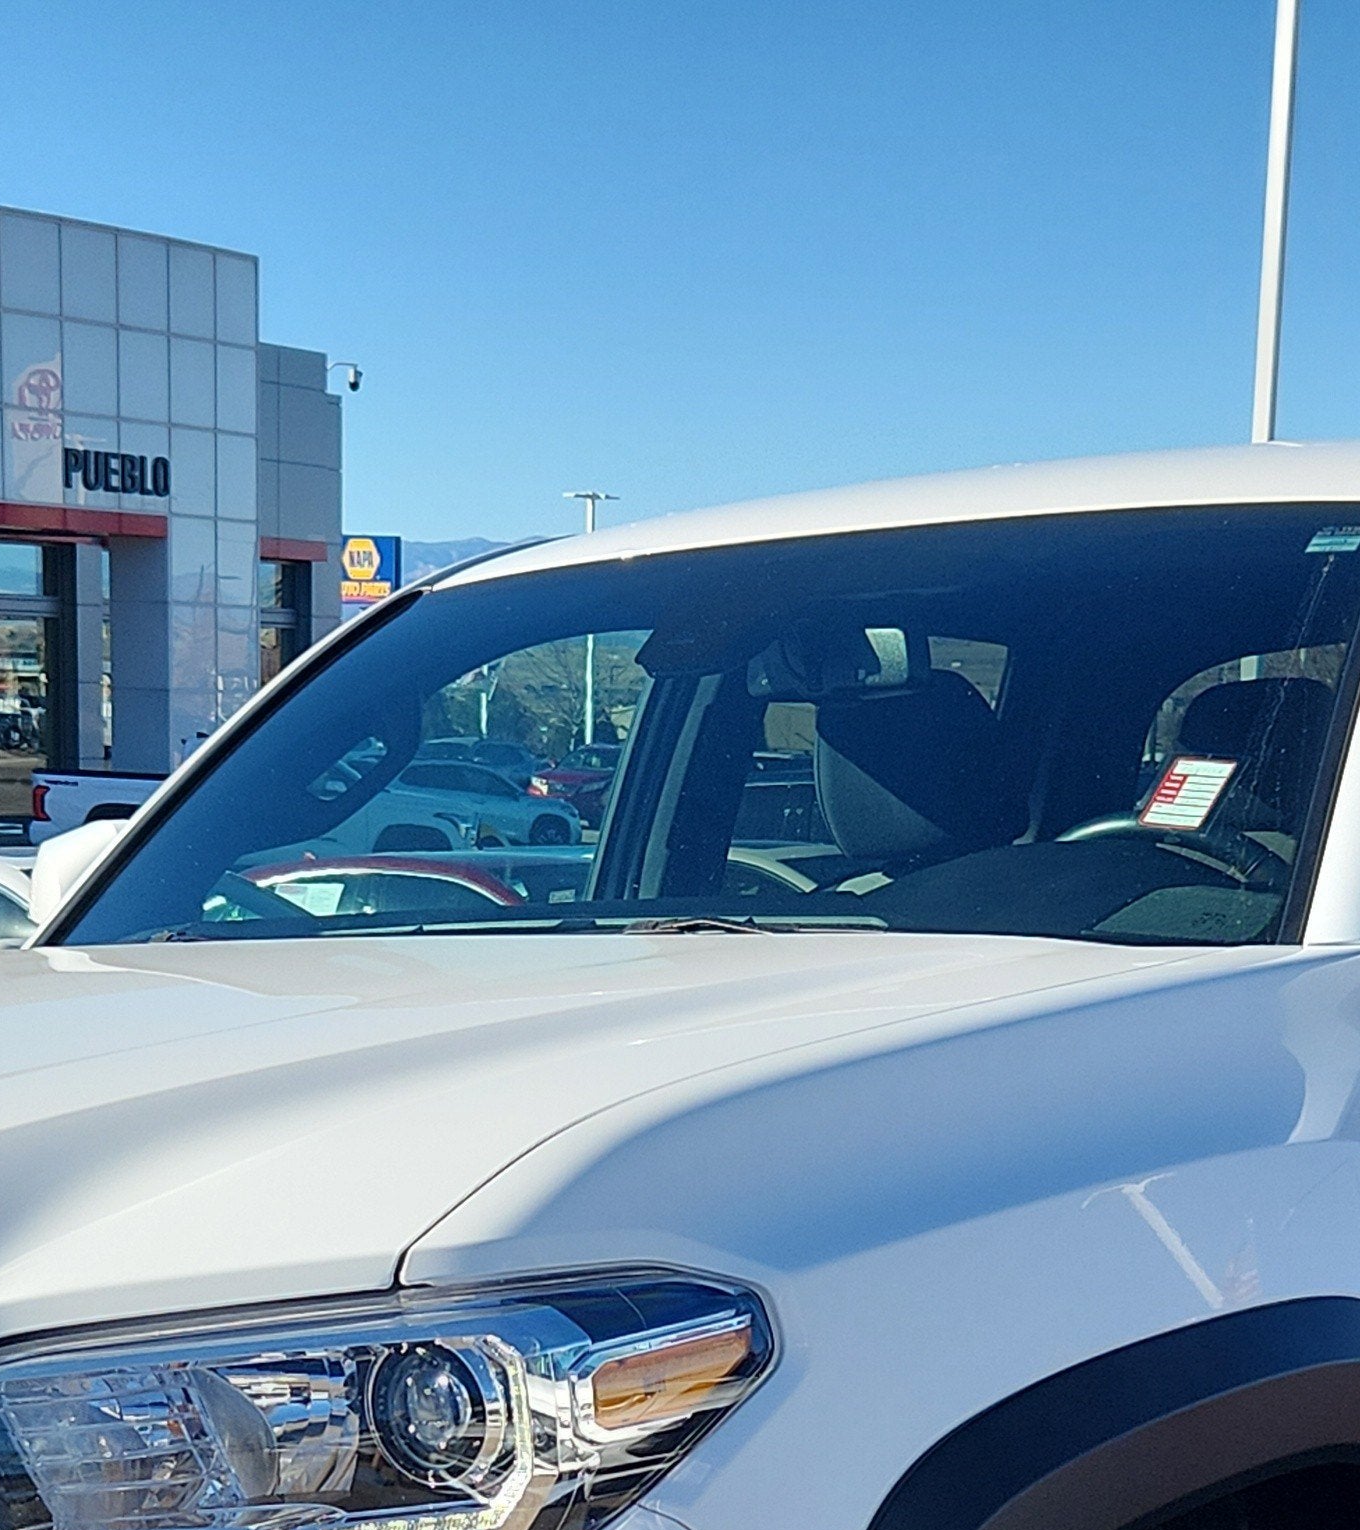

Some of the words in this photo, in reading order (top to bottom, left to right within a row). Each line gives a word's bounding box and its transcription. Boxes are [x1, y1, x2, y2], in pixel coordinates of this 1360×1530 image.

[62, 447, 171, 497] PUEBLO
[349, 550, 374, 568] NAPA
[341, 581, 359, 597] UTO
[361, 581, 391, 598] PARTS
